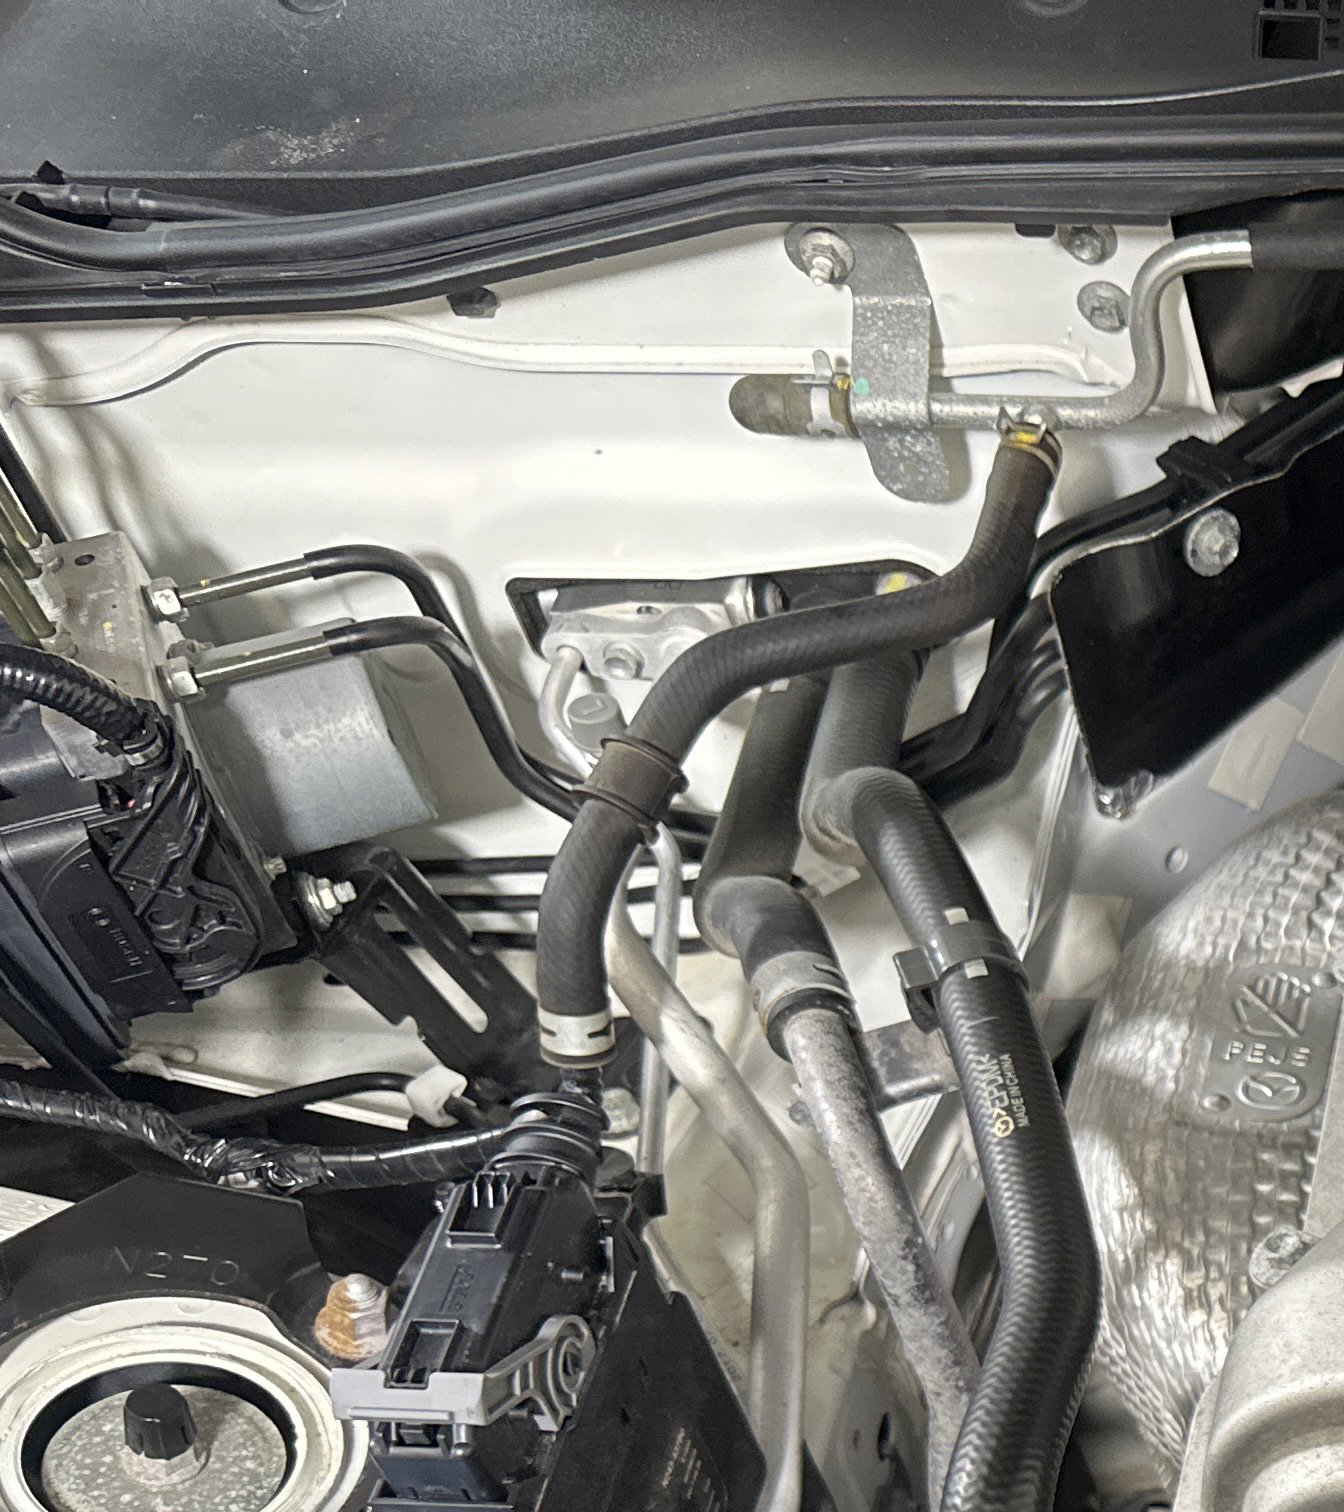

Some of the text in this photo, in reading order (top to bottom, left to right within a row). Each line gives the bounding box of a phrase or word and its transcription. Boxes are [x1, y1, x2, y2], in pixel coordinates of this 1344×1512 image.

[1000, 1053, 1030, 1126] MADE IN CHINA
